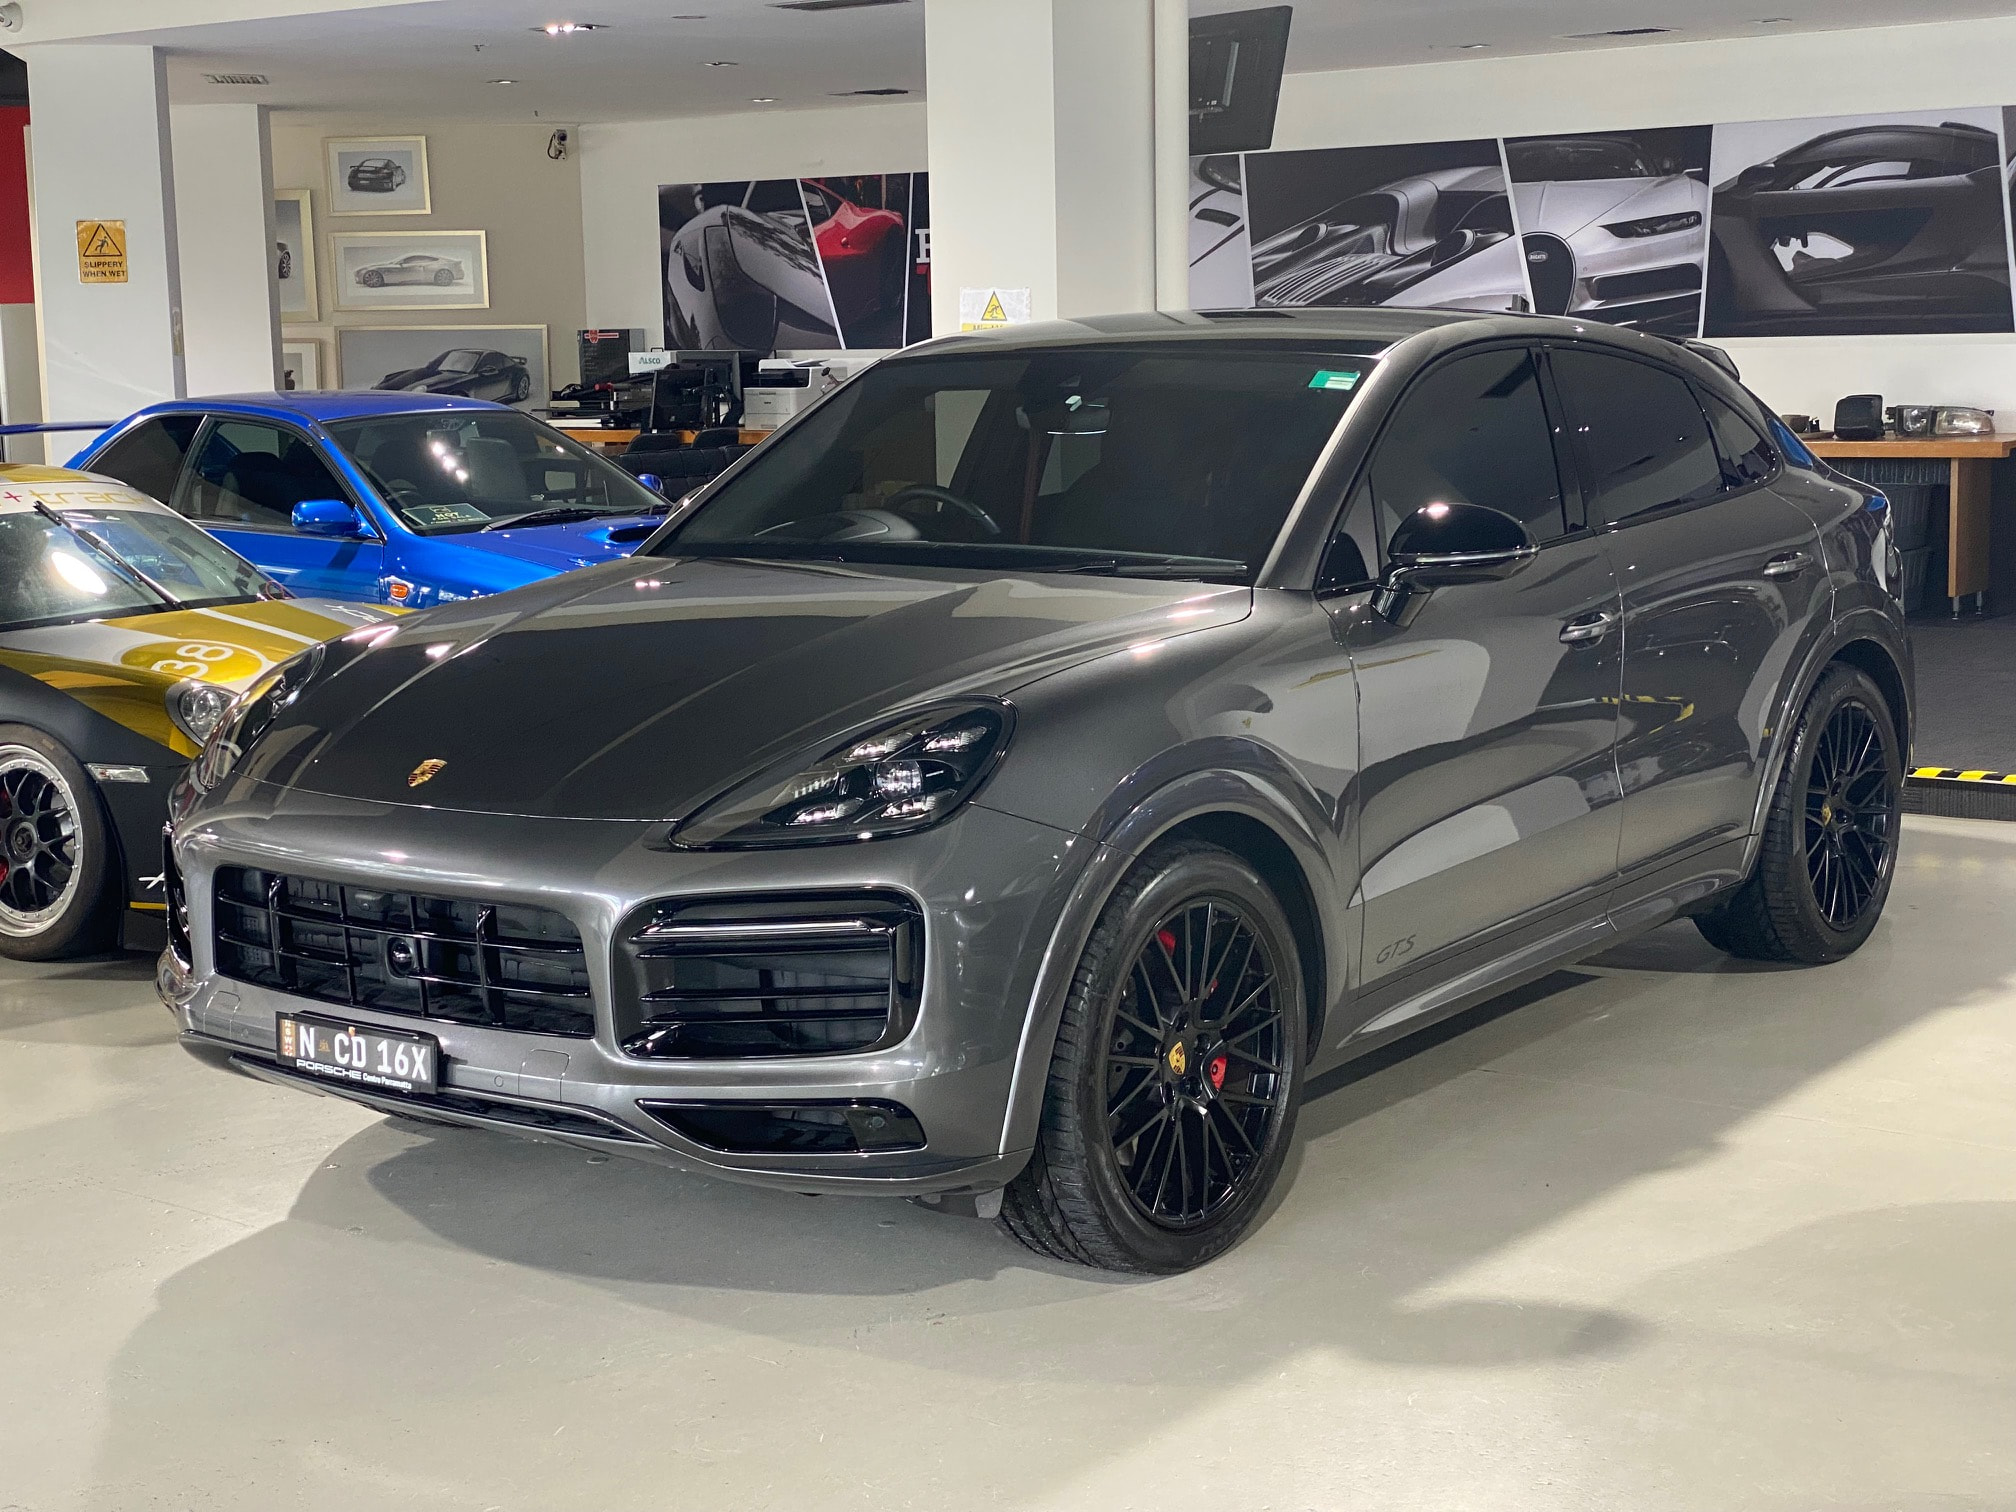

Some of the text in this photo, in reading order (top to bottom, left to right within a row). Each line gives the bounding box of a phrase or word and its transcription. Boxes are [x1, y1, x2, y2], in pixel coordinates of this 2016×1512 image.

[150, 644, 234, 682] 38
[1376, 934, 1417, 964] GTS
[296, 1058, 362, 1080] PORSCHE
[376, 1039, 428, 1081] 16X
